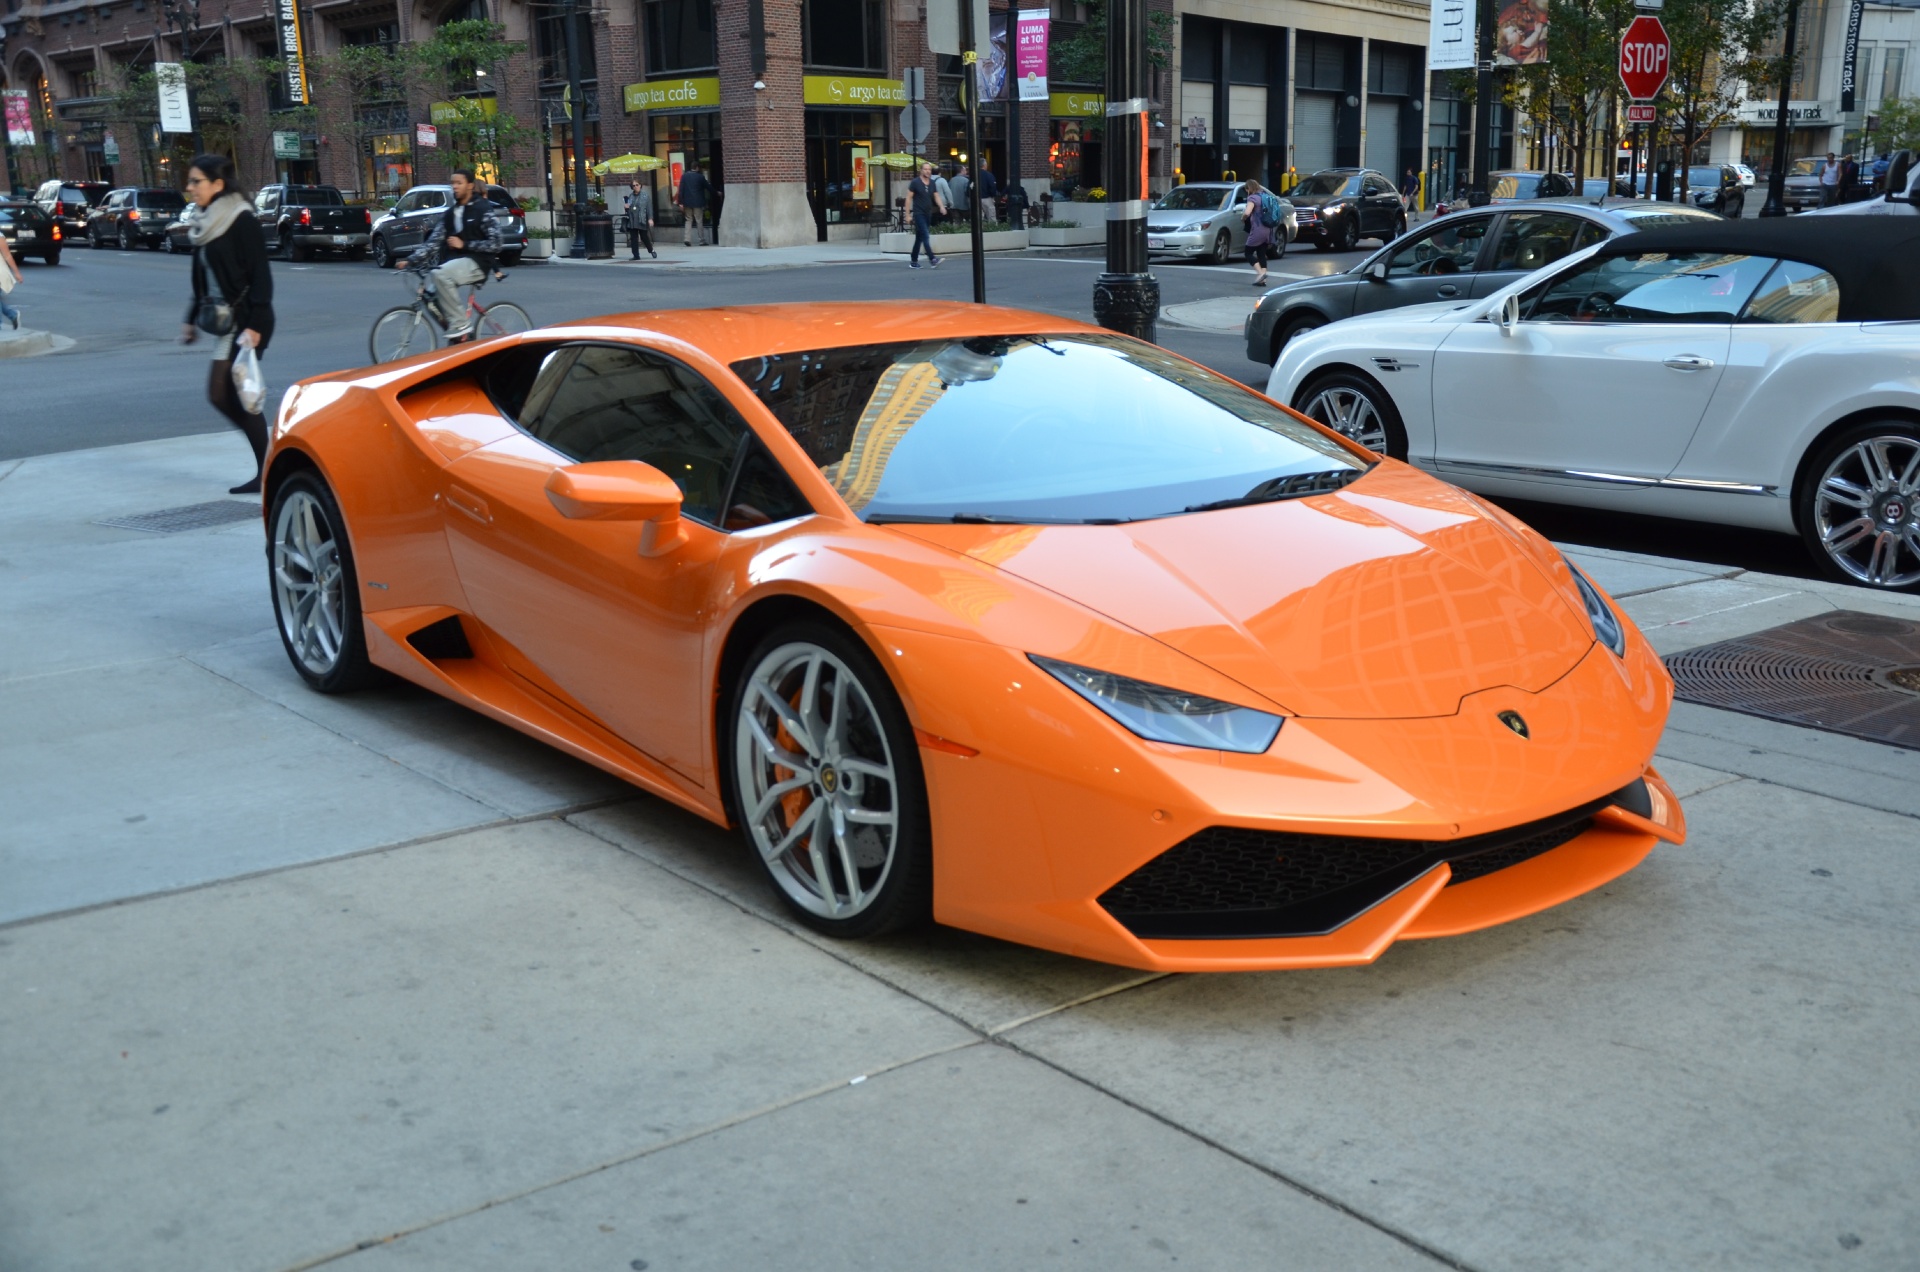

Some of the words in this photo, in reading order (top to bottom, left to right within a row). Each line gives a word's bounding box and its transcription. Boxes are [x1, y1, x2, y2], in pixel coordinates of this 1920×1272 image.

[282, 23, 298, 52] BROS.
[1021, 25, 1044, 35] LUMA
[1021, 36, 1029, 44] at
[1031, 34, 1044, 43] 10!
[1845, 0, 1862, 62] ORDSTROM
[1623, 42, 1667, 73] STOP
[286, 54, 303, 102] EINSTEIN
[1842, 65, 1855, 93] rack
[633, 92, 649, 108] argo
[650, 88, 665, 102] tea
[668, 80, 698, 101] café
[849, 86, 876, 102] argo
[878, 85, 891, 99] tea
[1083, 99, 1102, 115] argo
[1630, 109, 1640, 118] ALL
[1641, 109, 1653, 118] WAY
[1803, 105, 1822, 119] rack
